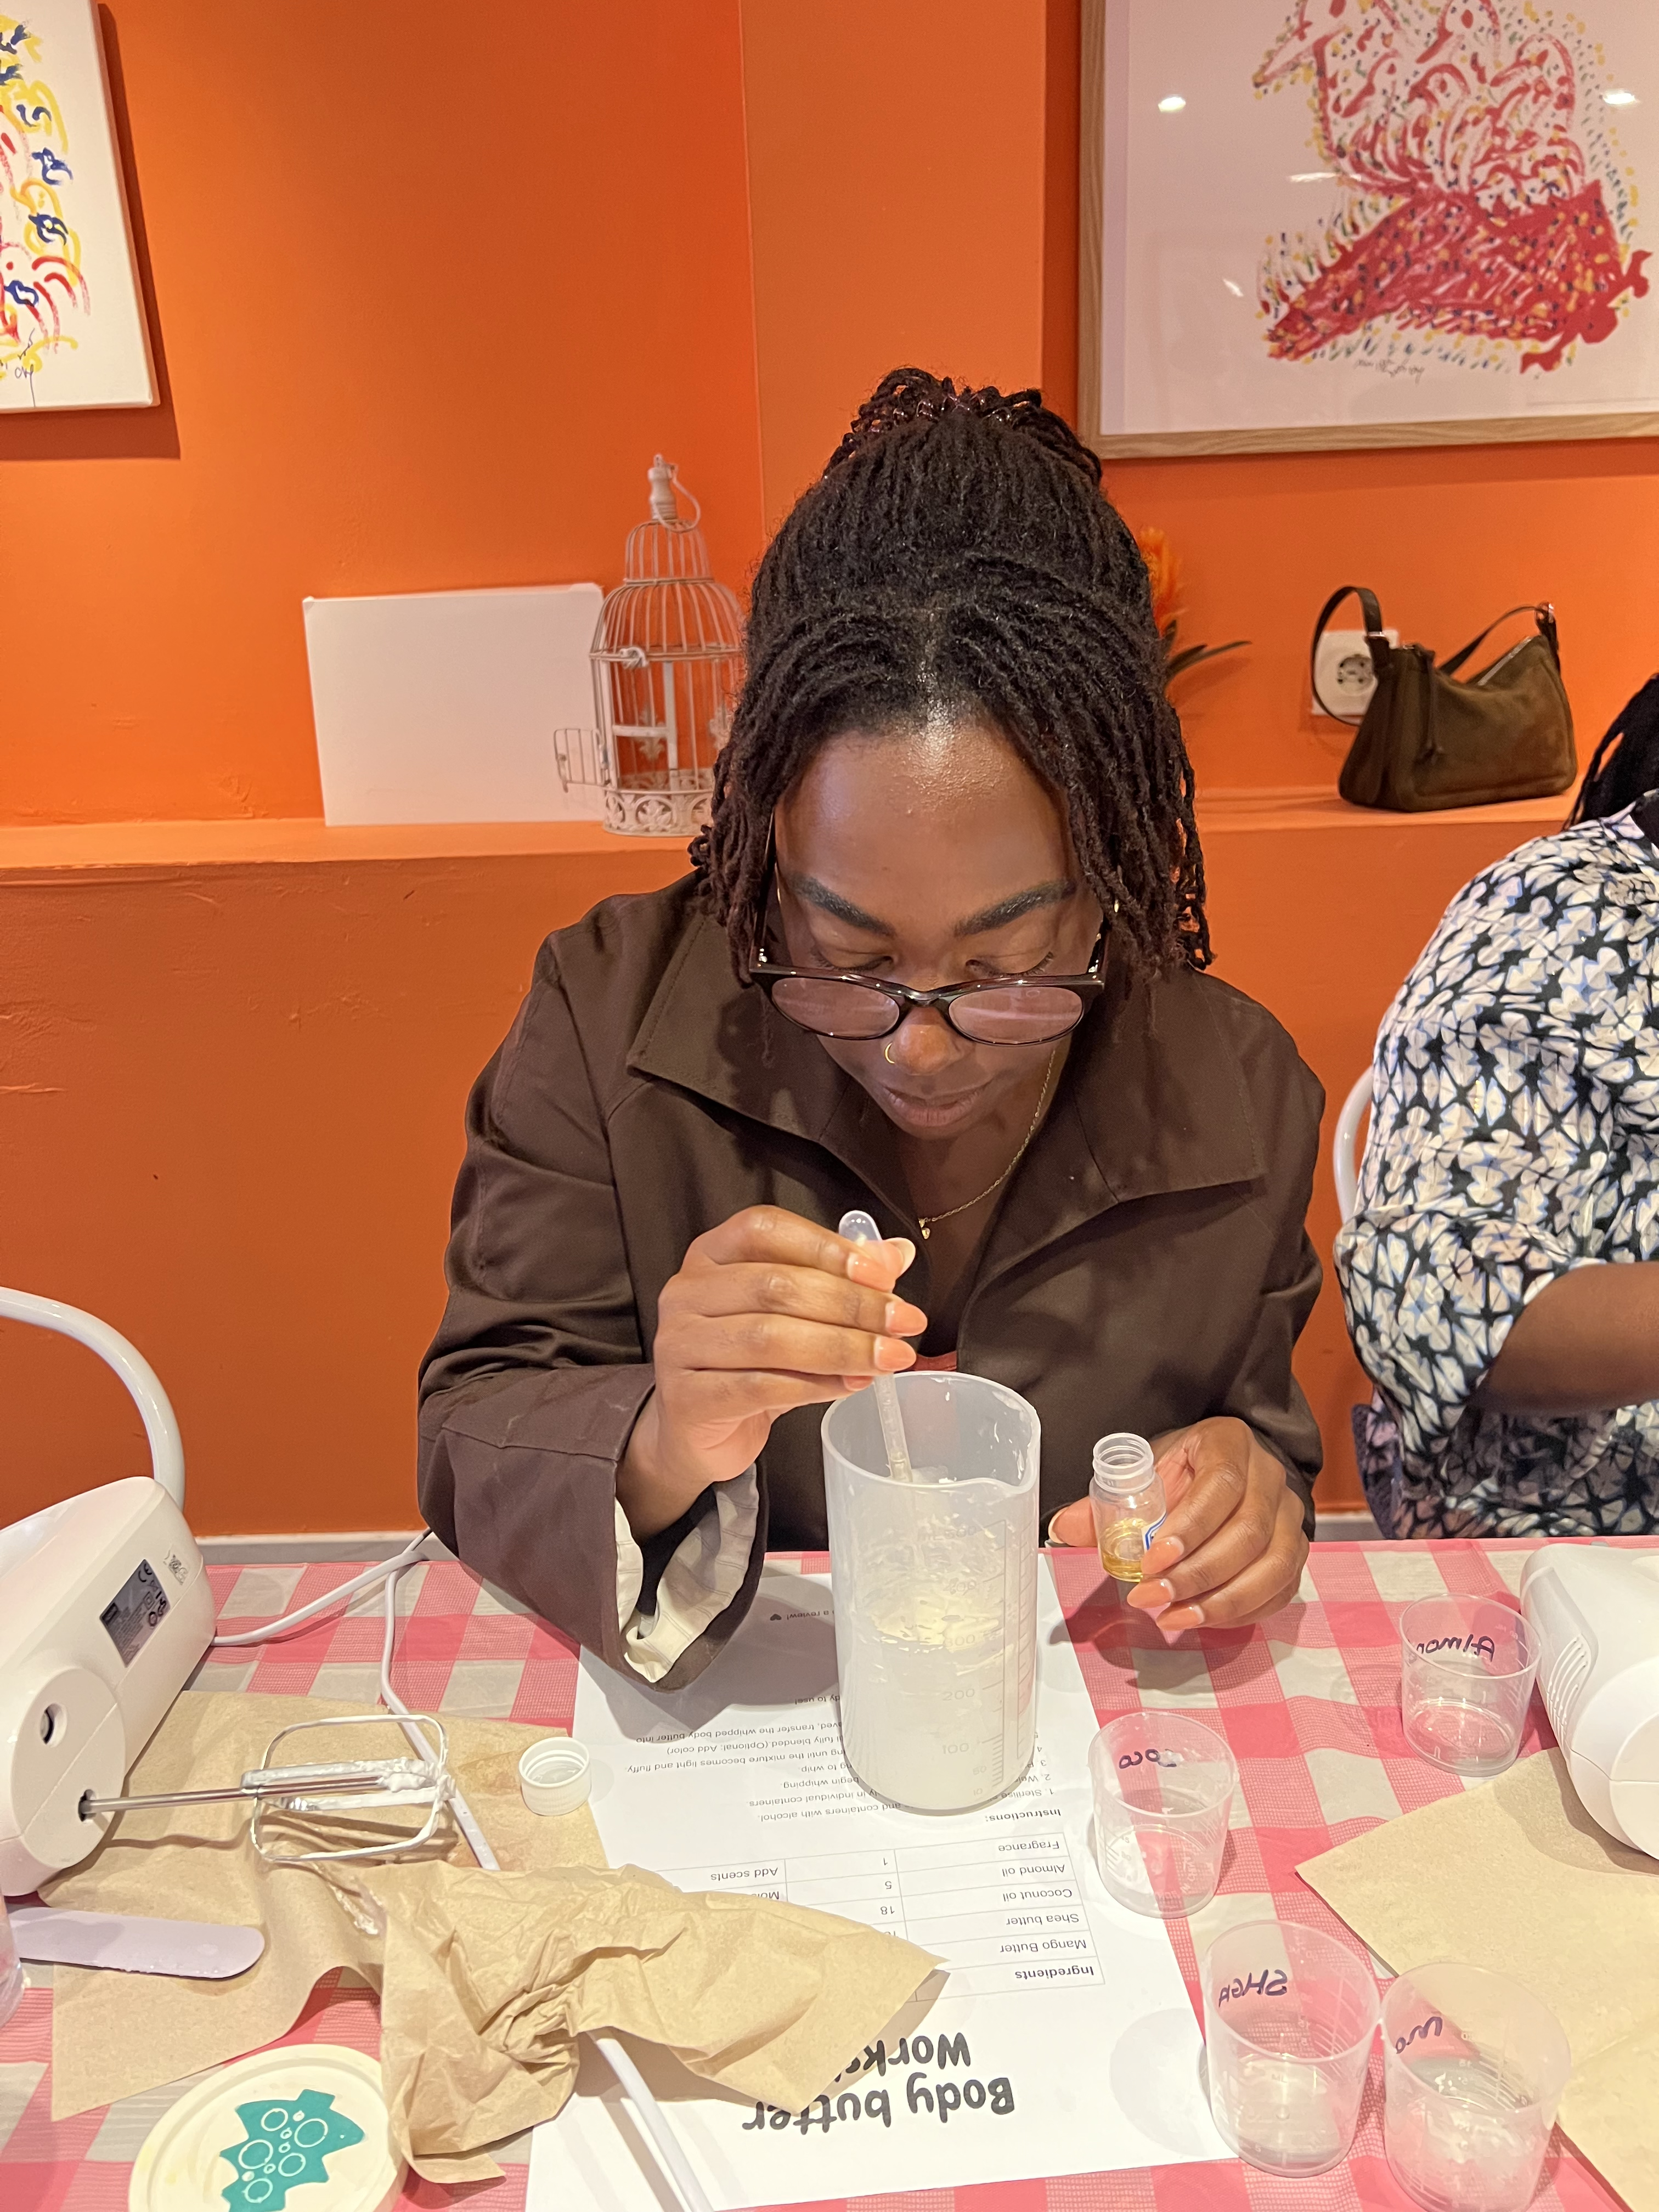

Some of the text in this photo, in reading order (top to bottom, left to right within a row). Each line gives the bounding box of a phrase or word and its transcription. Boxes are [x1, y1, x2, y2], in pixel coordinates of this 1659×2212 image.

[787, 1611, 820, 1621] review!
[942, 1688, 975, 1701] 200
[794, 1697, 814, 1705] use!
[657, 1733, 685, 1742] butter
[689, 1730, 712, 1739] body
[715, 1729, 756, 1737] whipped
[636, 1736, 654, 1745] into
[667, 1747, 694, 1755] color)
[942, 1742, 969, 1754] 100
[676, 1760, 696, 1768] light
[780, 1776, 859, 1790] begin whipping.
[806, 1792, 853, 1802] individual
[857, 1790, 866, 1799] in
[1001, 1790, 1041, 1800] Sterilise
[746, 1797, 802, 1808] containers.
[882, 1802, 901, 1811] and
[826, 1805, 878, 1814] containers
[758, 1813, 797, 1822] alcohol.
[985, 1809, 1061, 1821] Instructions:
[998, 1841, 1059, 1851] Fragrance
[710, 1867, 778, 1881] Add scents
[1002, 1864, 1065, 1877] Almond oil
[885, 1881, 891, 1889] 5
[1003, 1889, 1072, 1902] Coconut oil
[881, 1906, 895, 1915] 18
[1006, 1914, 1079, 1925] Shea butter
[1000, 1939, 1086, 1953] Mango Butter
[1015, 1965, 1094, 1979] Ingredients
[742, 2072, 1015, 2135] Body butter
